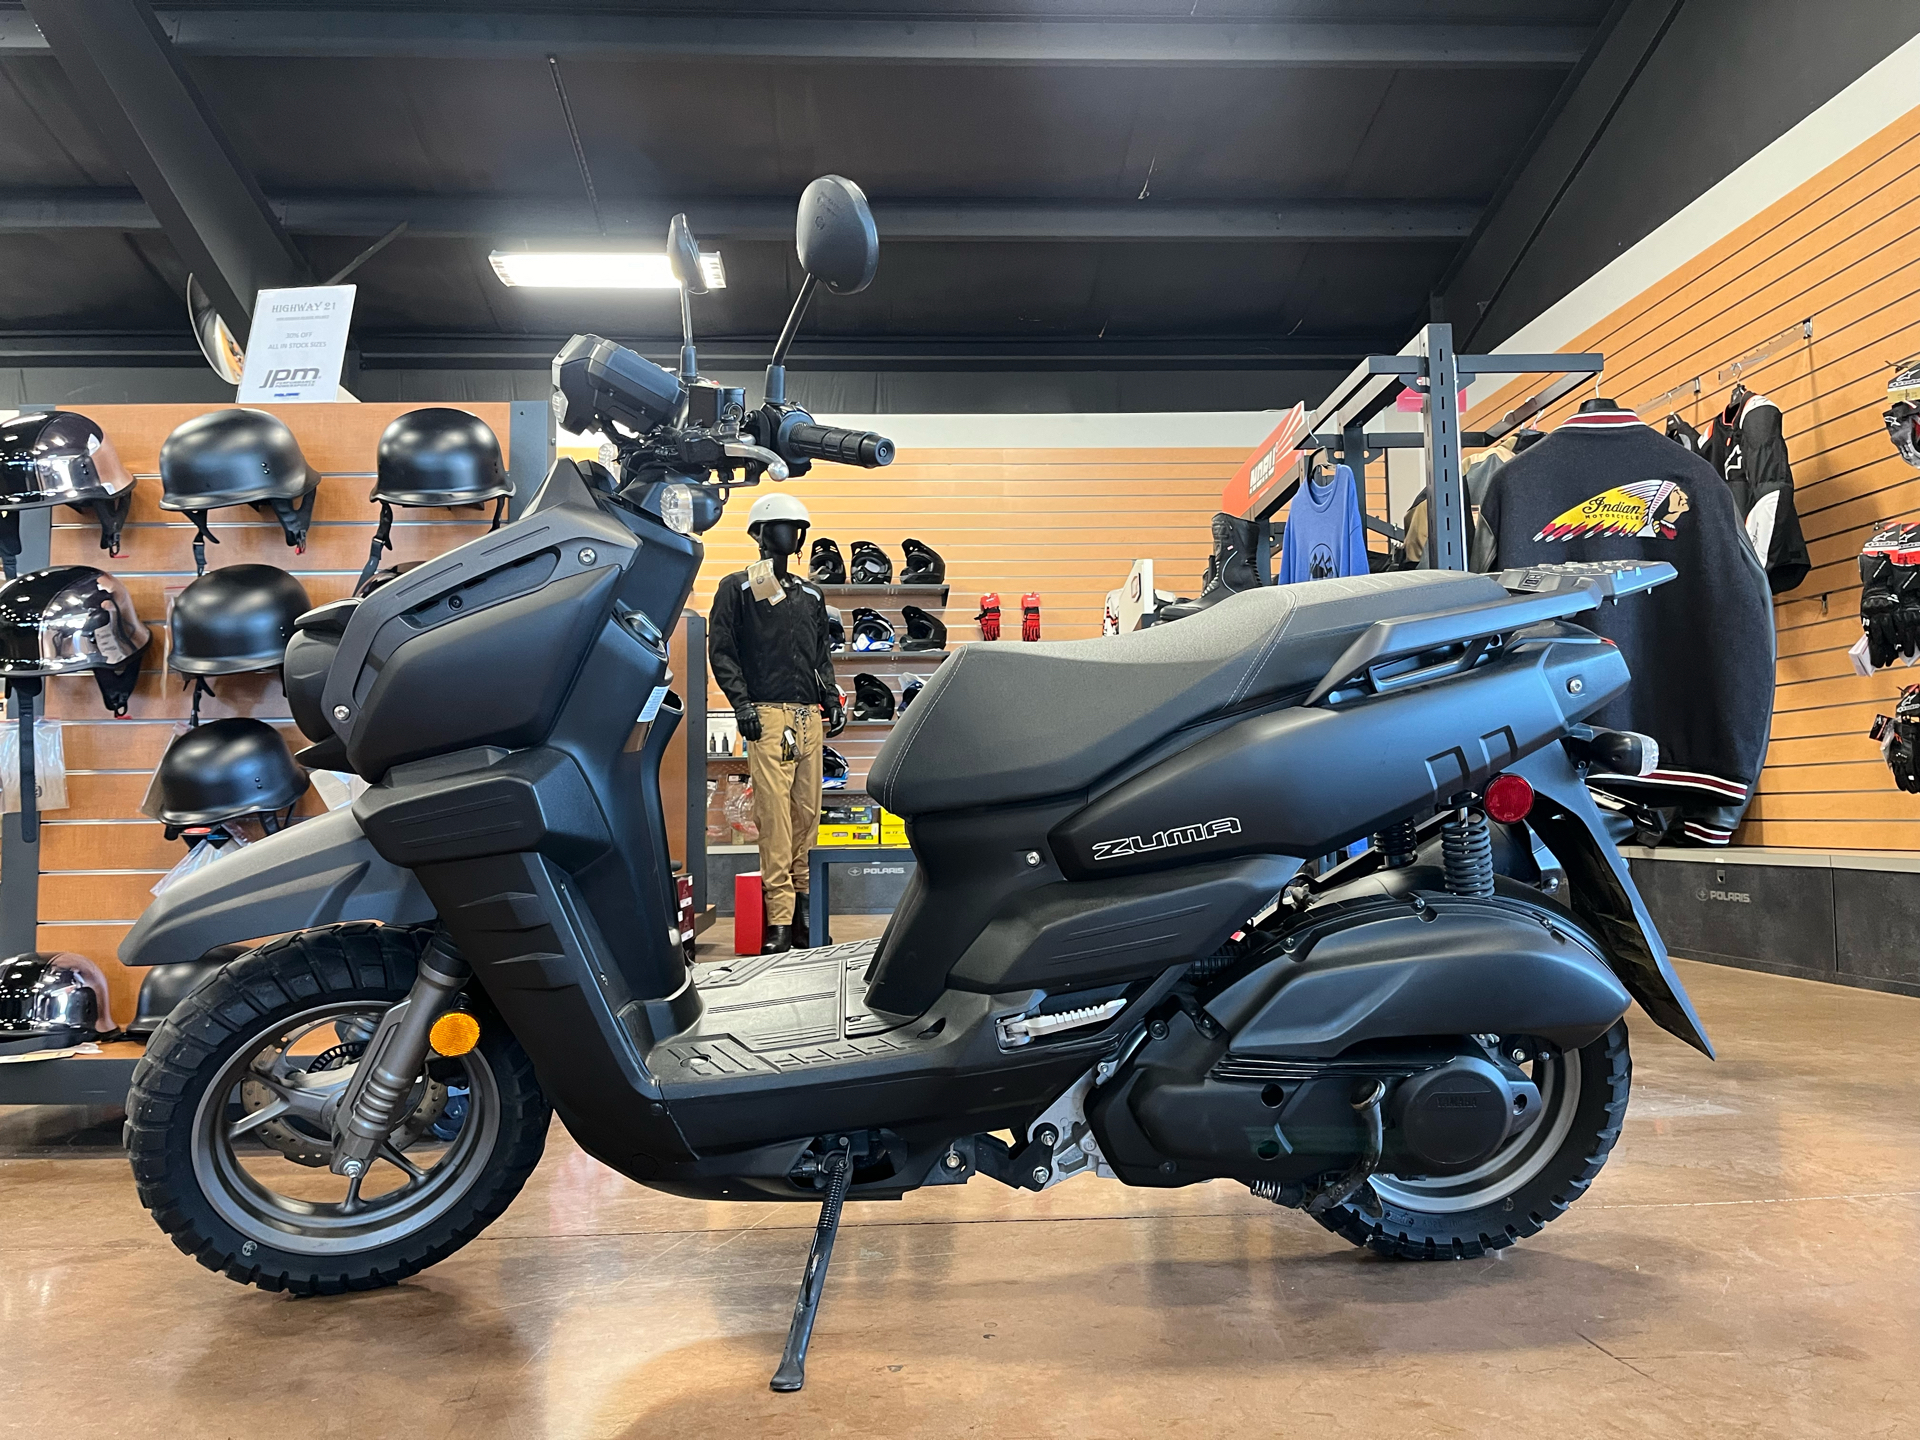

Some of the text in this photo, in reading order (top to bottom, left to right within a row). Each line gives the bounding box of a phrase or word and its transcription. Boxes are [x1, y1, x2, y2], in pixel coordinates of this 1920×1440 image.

[272, 302, 336, 313] HIGHWAY 21
[1582, 496, 1641, 514] Indian
[1092, 817, 1242, 860] ZUMA
[863, 867, 905, 875] POLARIS
[1710, 890, 1750, 903] POLARIS
